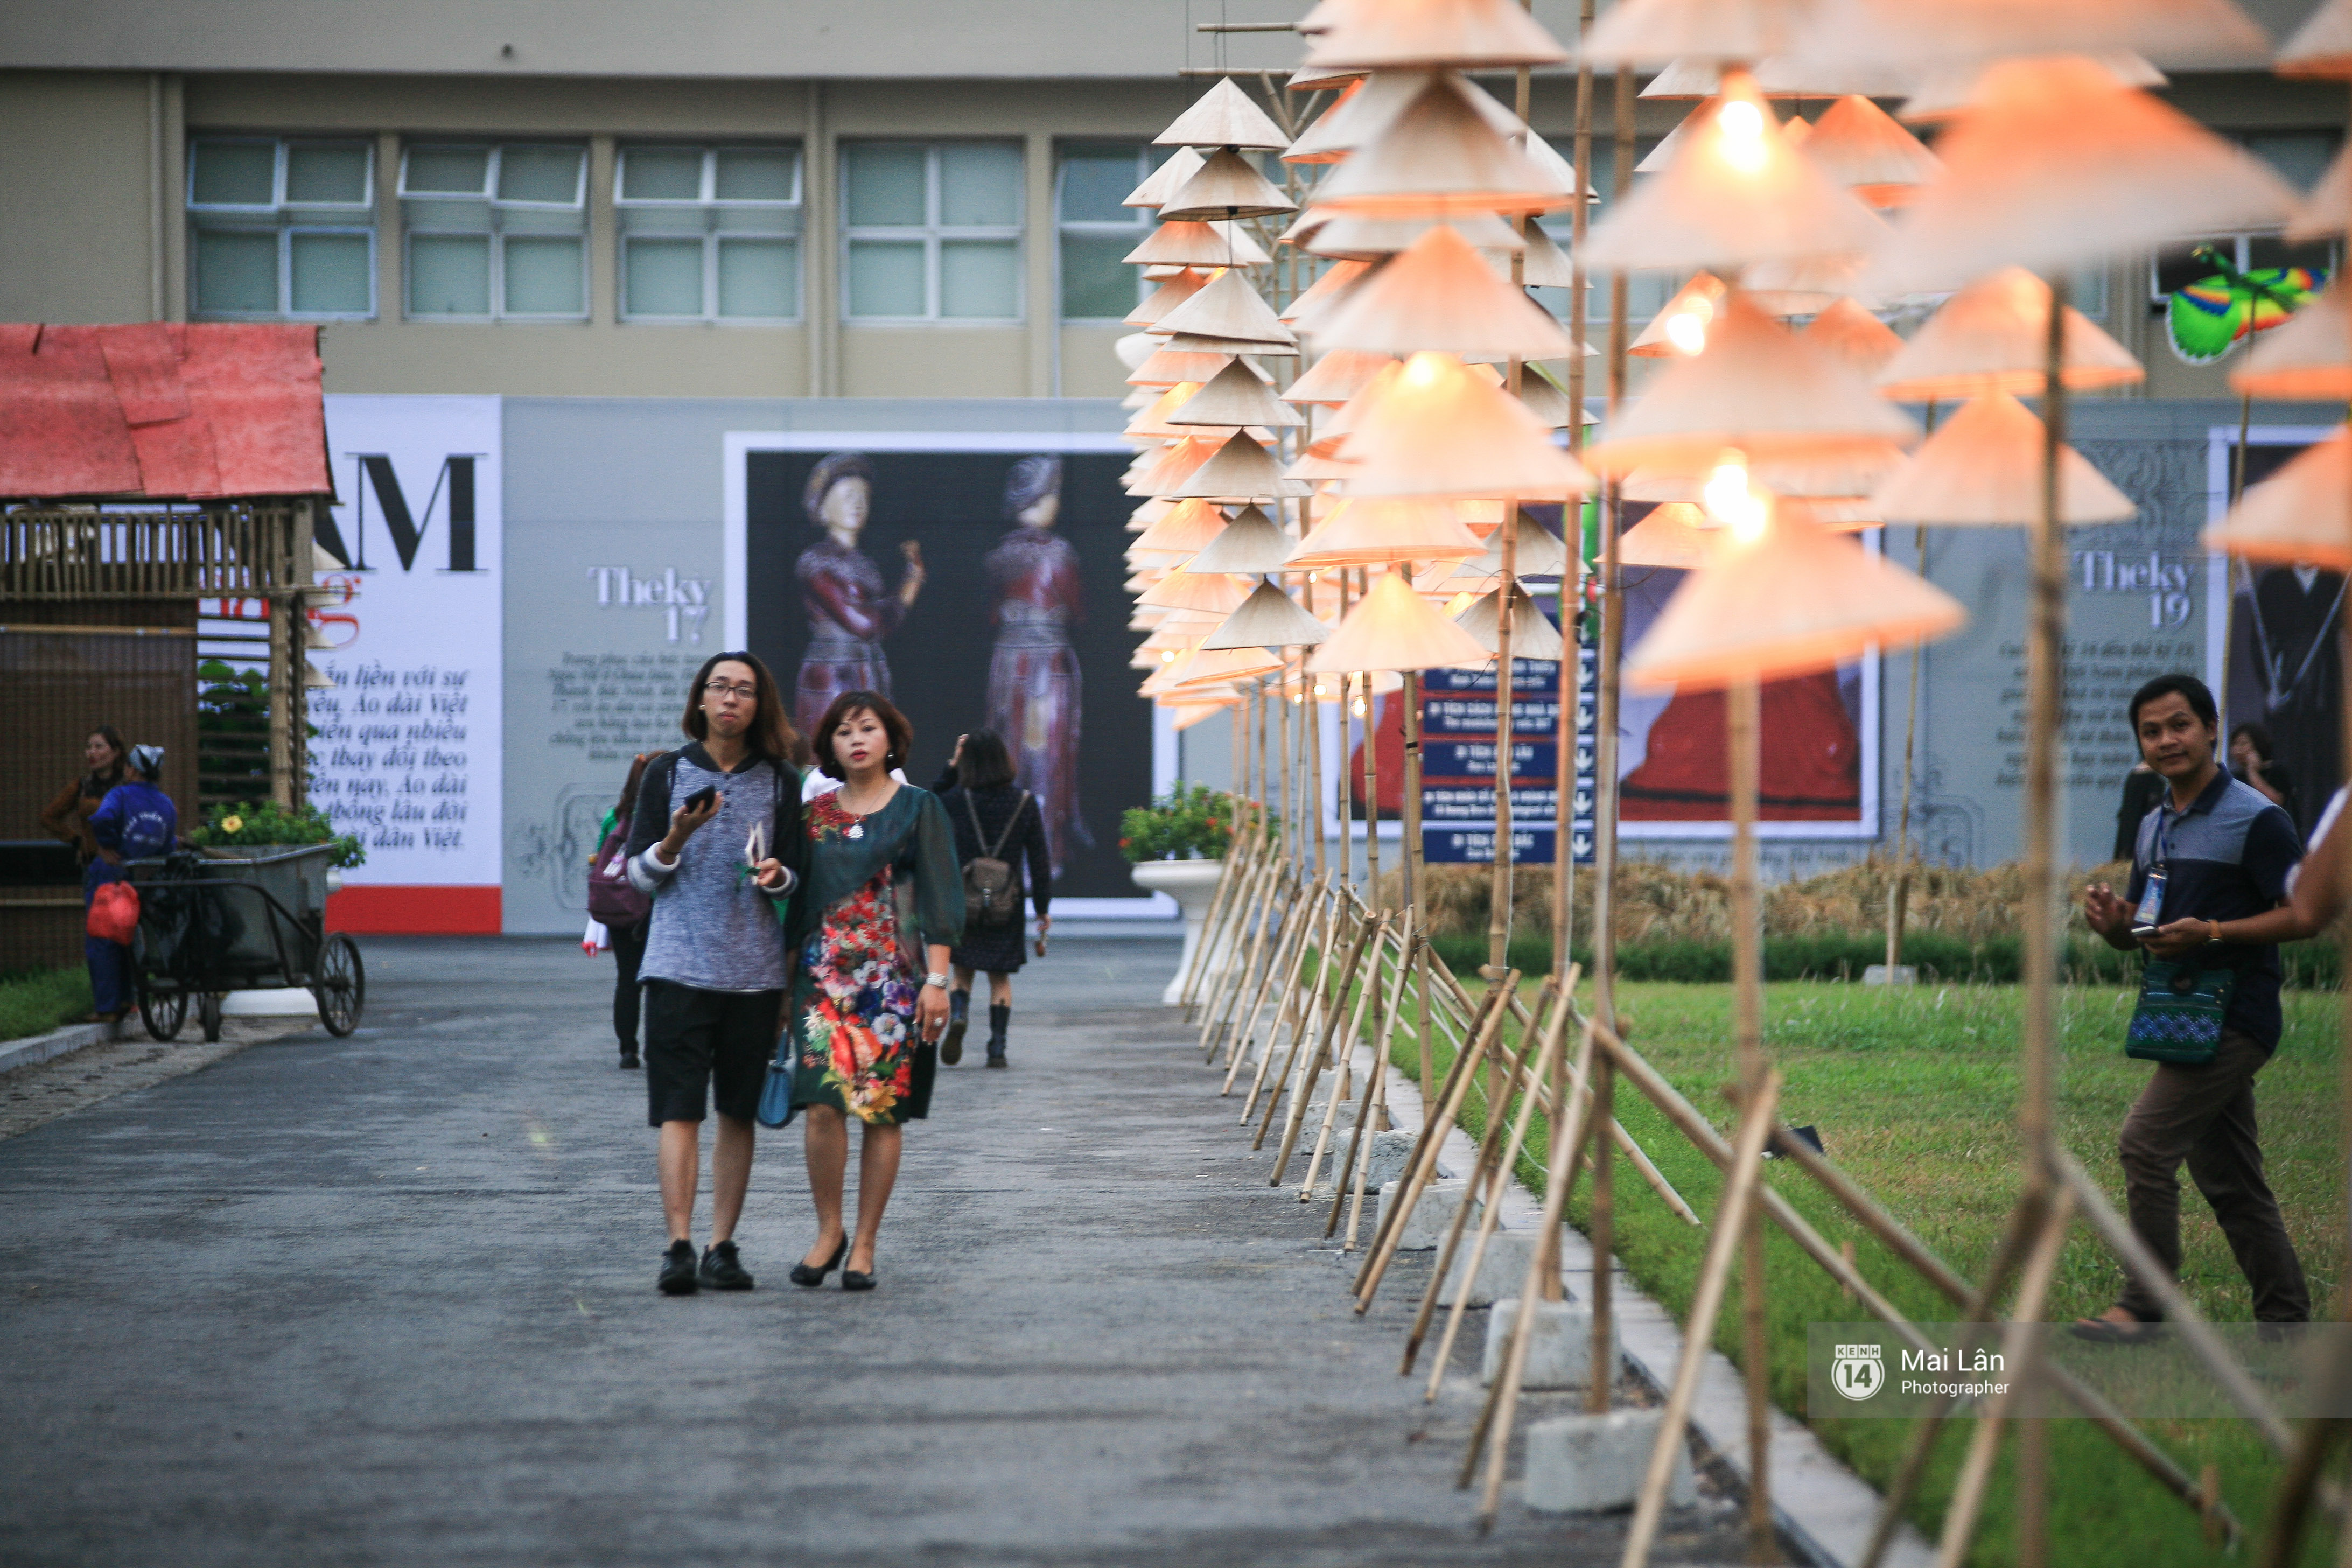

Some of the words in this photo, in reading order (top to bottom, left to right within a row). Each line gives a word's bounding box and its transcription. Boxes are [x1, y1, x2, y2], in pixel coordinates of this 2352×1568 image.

[2146, 593, 2190, 627] 19
[664, 606, 708, 642] 17
[403, 665, 436, 686] với
[386, 691, 421, 712] dài
[358, 724, 400, 746] qua
[330, 745, 375, 774] thay
[423, 746, 467, 766] theo
[431, 772, 468, 793] dài
[391, 799, 425, 820] lâu
[372, 825, 415, 848] dân
